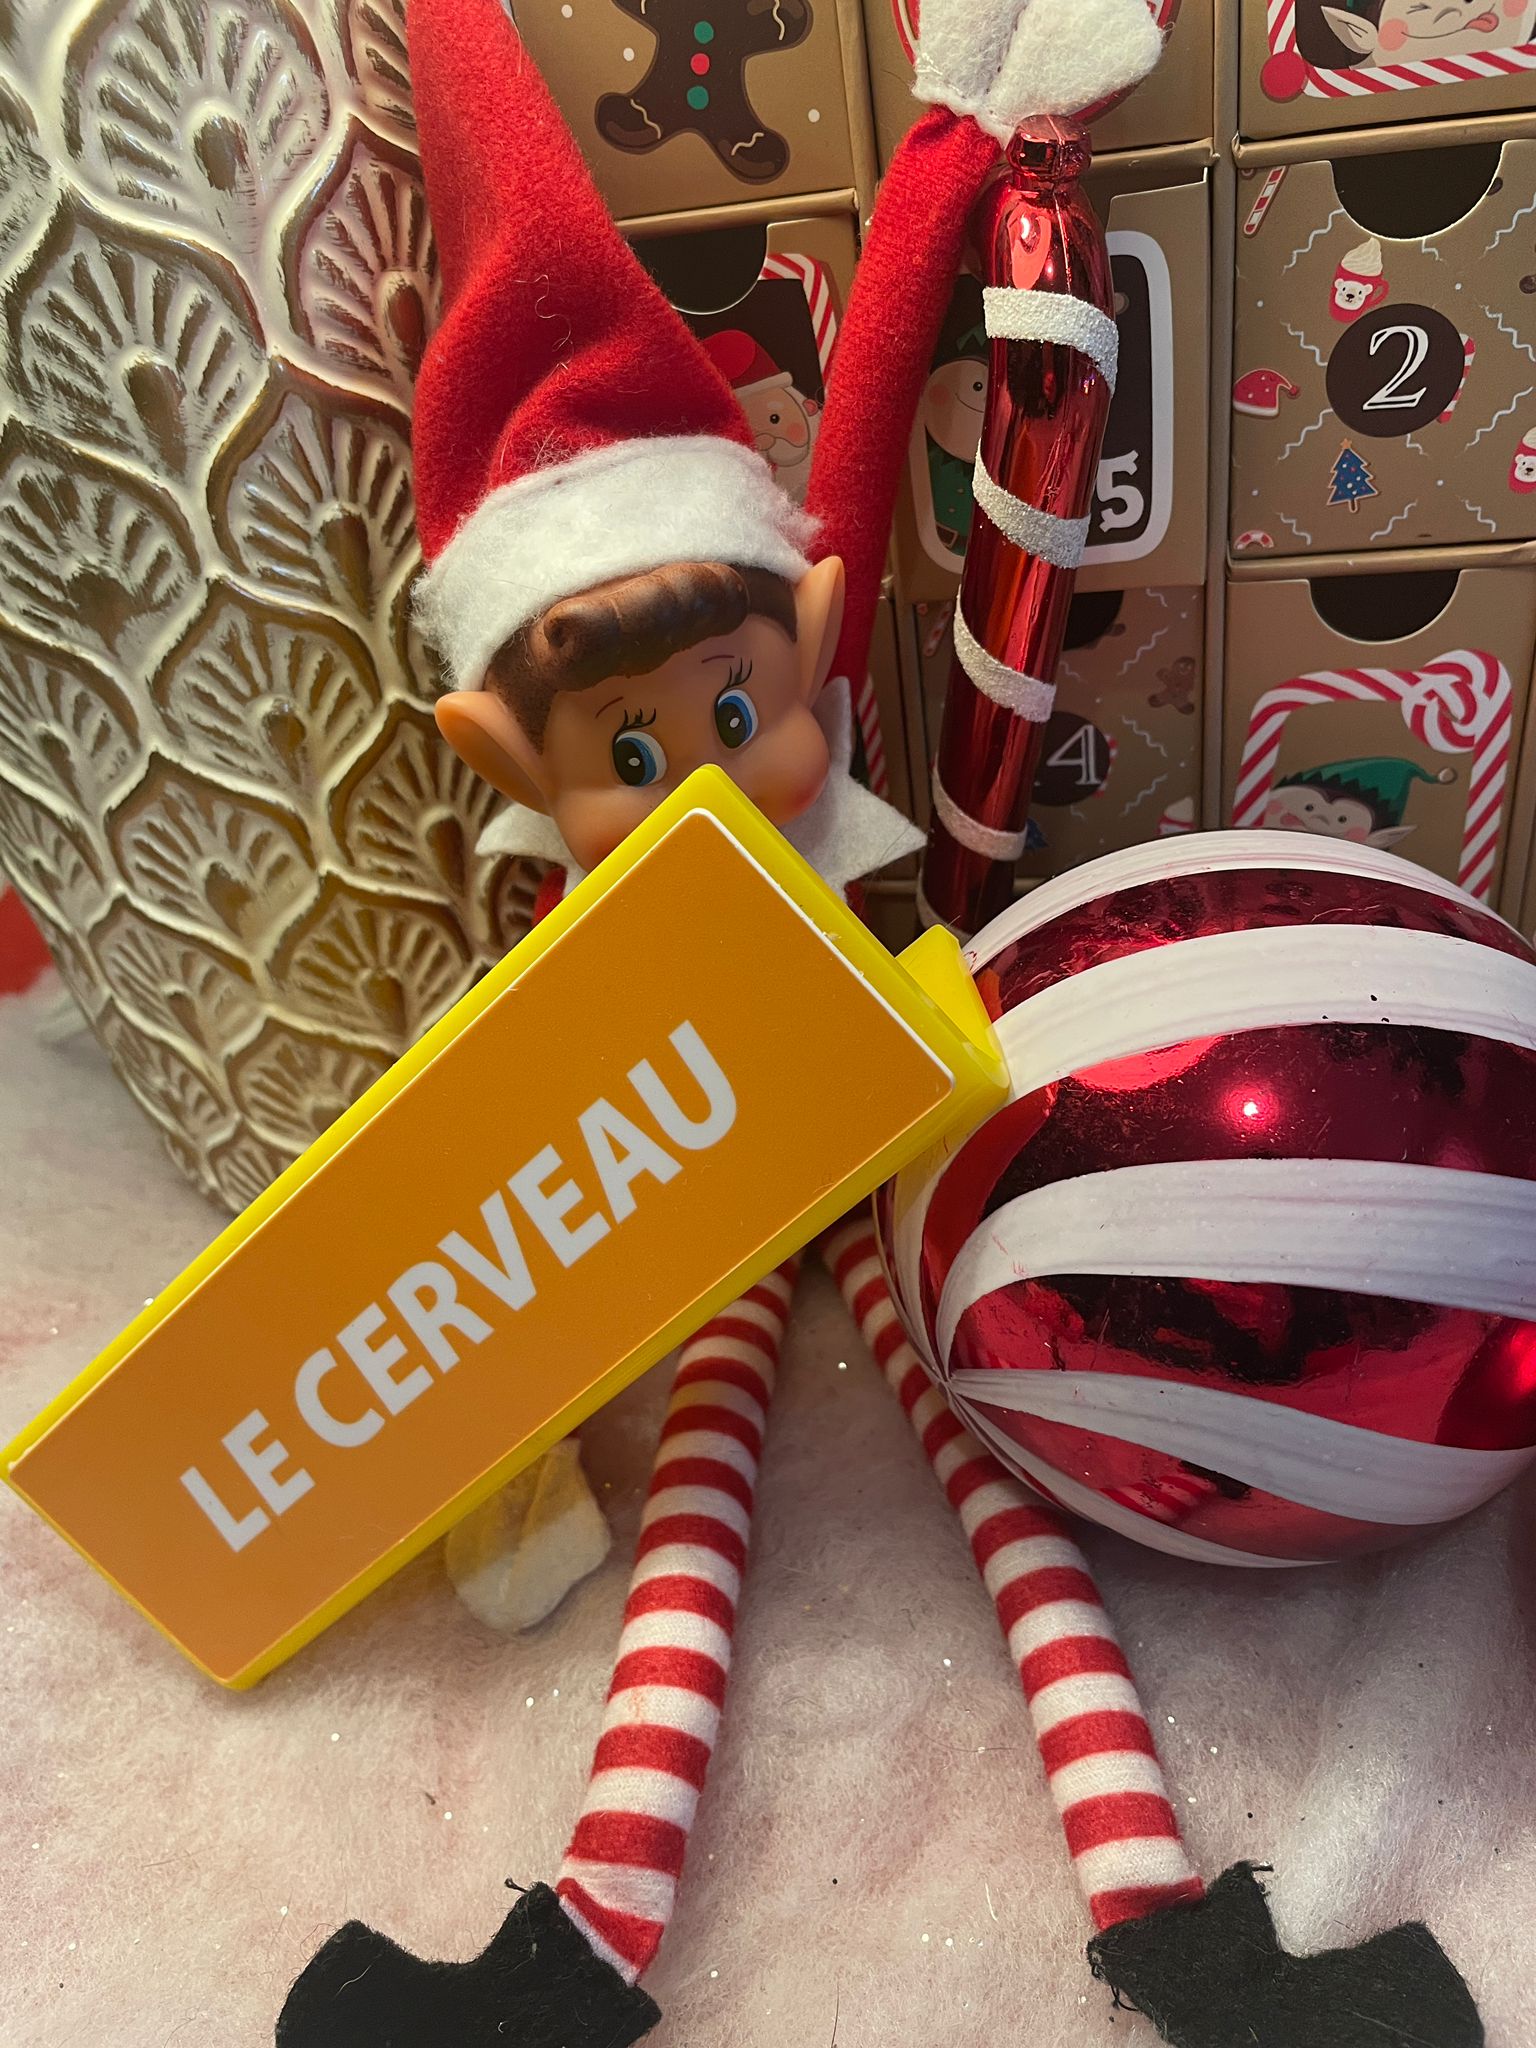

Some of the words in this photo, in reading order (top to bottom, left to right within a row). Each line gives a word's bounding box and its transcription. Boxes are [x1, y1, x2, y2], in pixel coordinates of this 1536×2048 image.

[1362, 325, 1429, 410] 2
[1096, 450, 1144, 533] 5
[1034, 724, 1101, 786] 4
[180, 1409, 315, 1553] LE
[294, 1019, 737, 1449] CERVEAU
